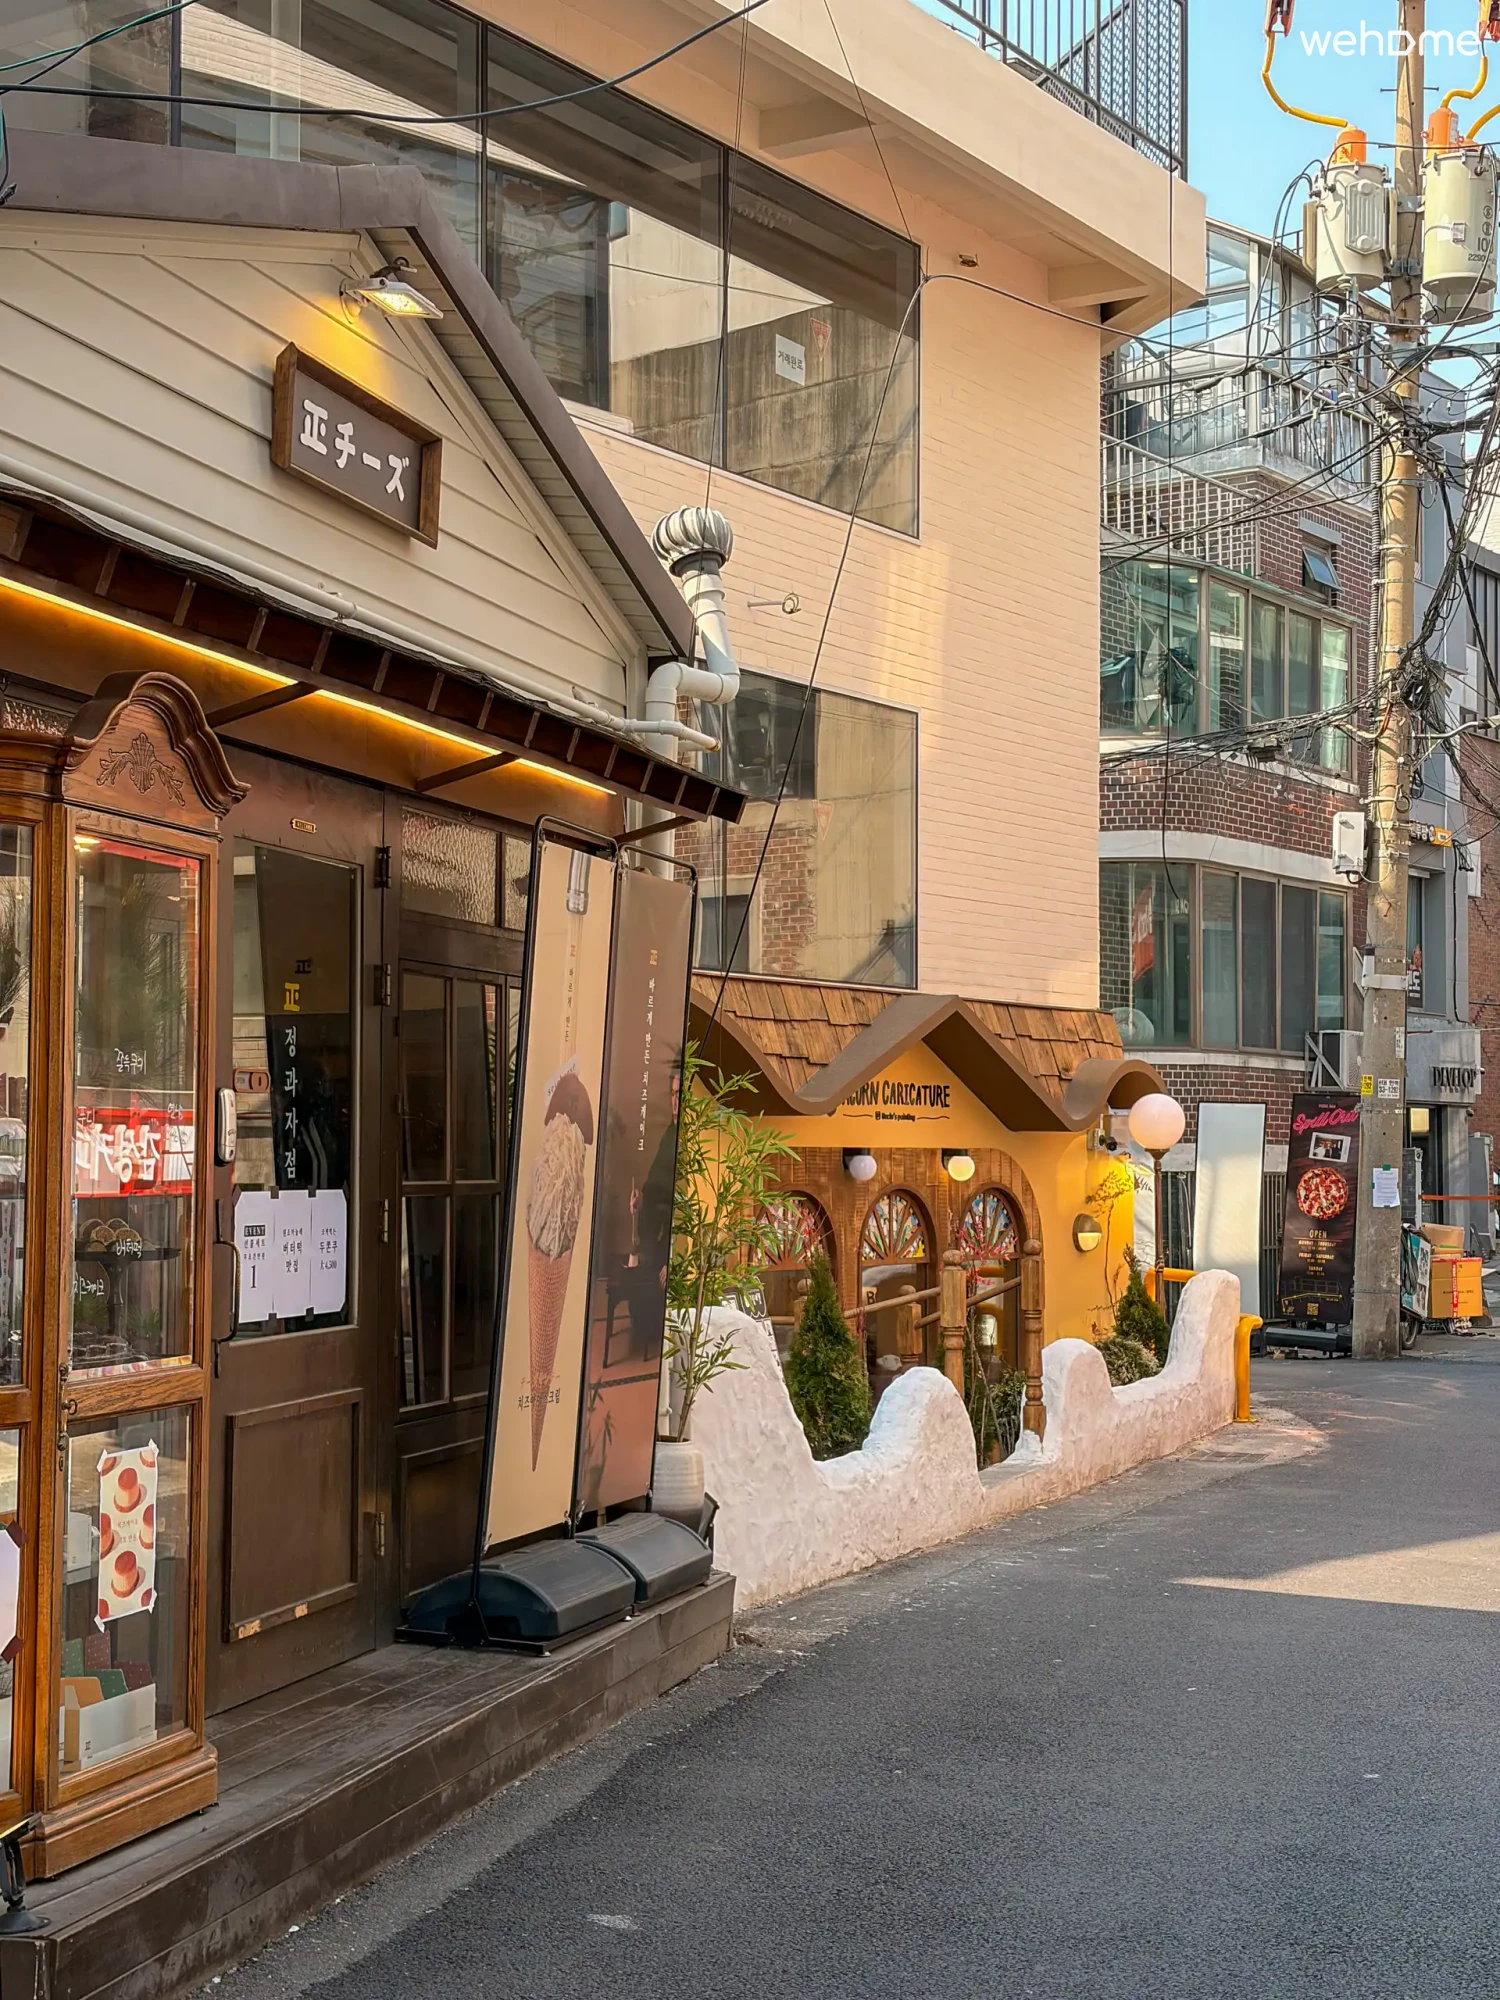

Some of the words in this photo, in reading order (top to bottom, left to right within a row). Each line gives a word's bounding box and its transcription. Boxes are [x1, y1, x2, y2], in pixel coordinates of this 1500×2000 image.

[777, 350, 804, 371] 거래완료
[299, 399, 409, 502] 正チーズ
[283, 982, 301, 1012] 正
[646, 977, 656, 1026] 바르게
[643, 1032, 653, 1064] 만든
[1432, 1066, 1476, 1088] DEVELOP
[283, 1026, 299, 1179] 정과자점
[882, 1080, 950, 1109] CARICATURE
[637, 1071, 649, 1151] 치즈케이크
[1293, 1111, 1330, 1135] Spill
[245, 1226, 265, 1236] EVENT
[1309, 1229, 1327, 1239] OPEN
[250, 1264, 257, 1289] 1
[285, 1258, 299, 1273] 맛집
